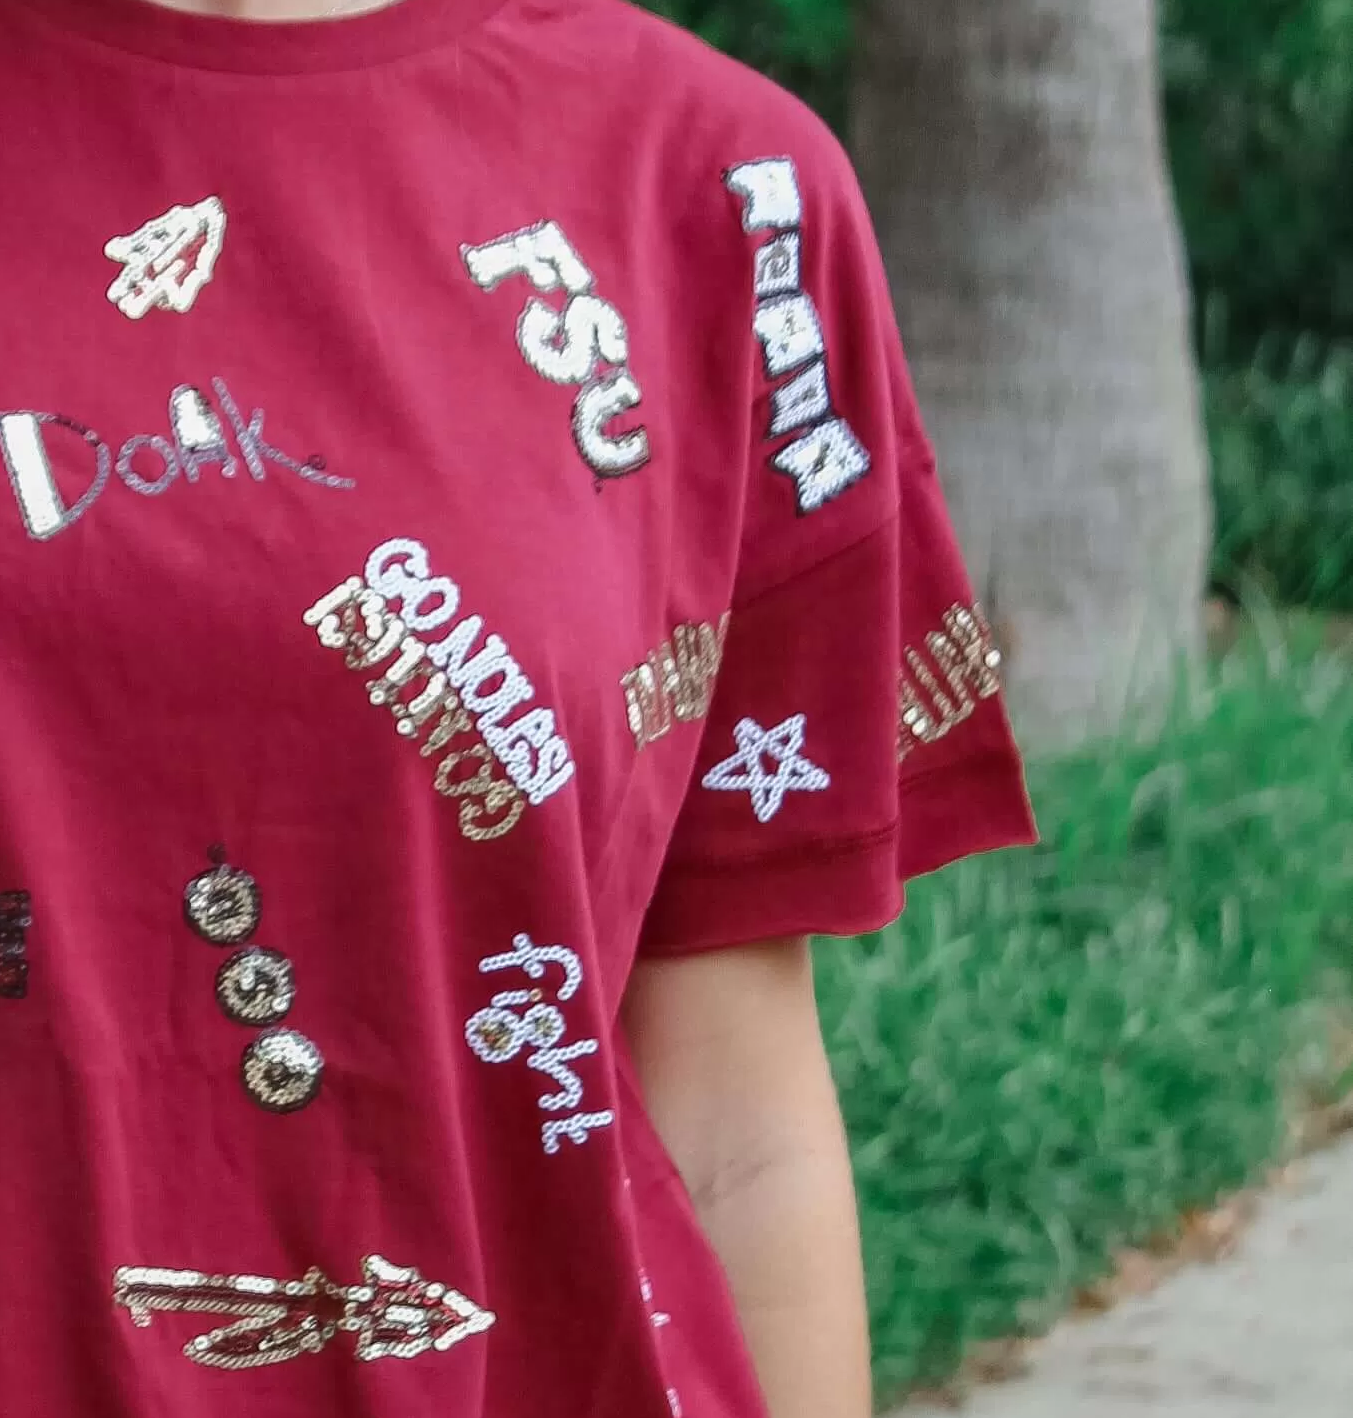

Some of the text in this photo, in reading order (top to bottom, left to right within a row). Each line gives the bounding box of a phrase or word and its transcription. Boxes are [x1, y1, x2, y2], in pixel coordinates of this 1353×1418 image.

[458, 217, 652, 479] FSU
[363, 537, 577, 806] GO NOLES!
[464, 931, 614, 1155] fight
